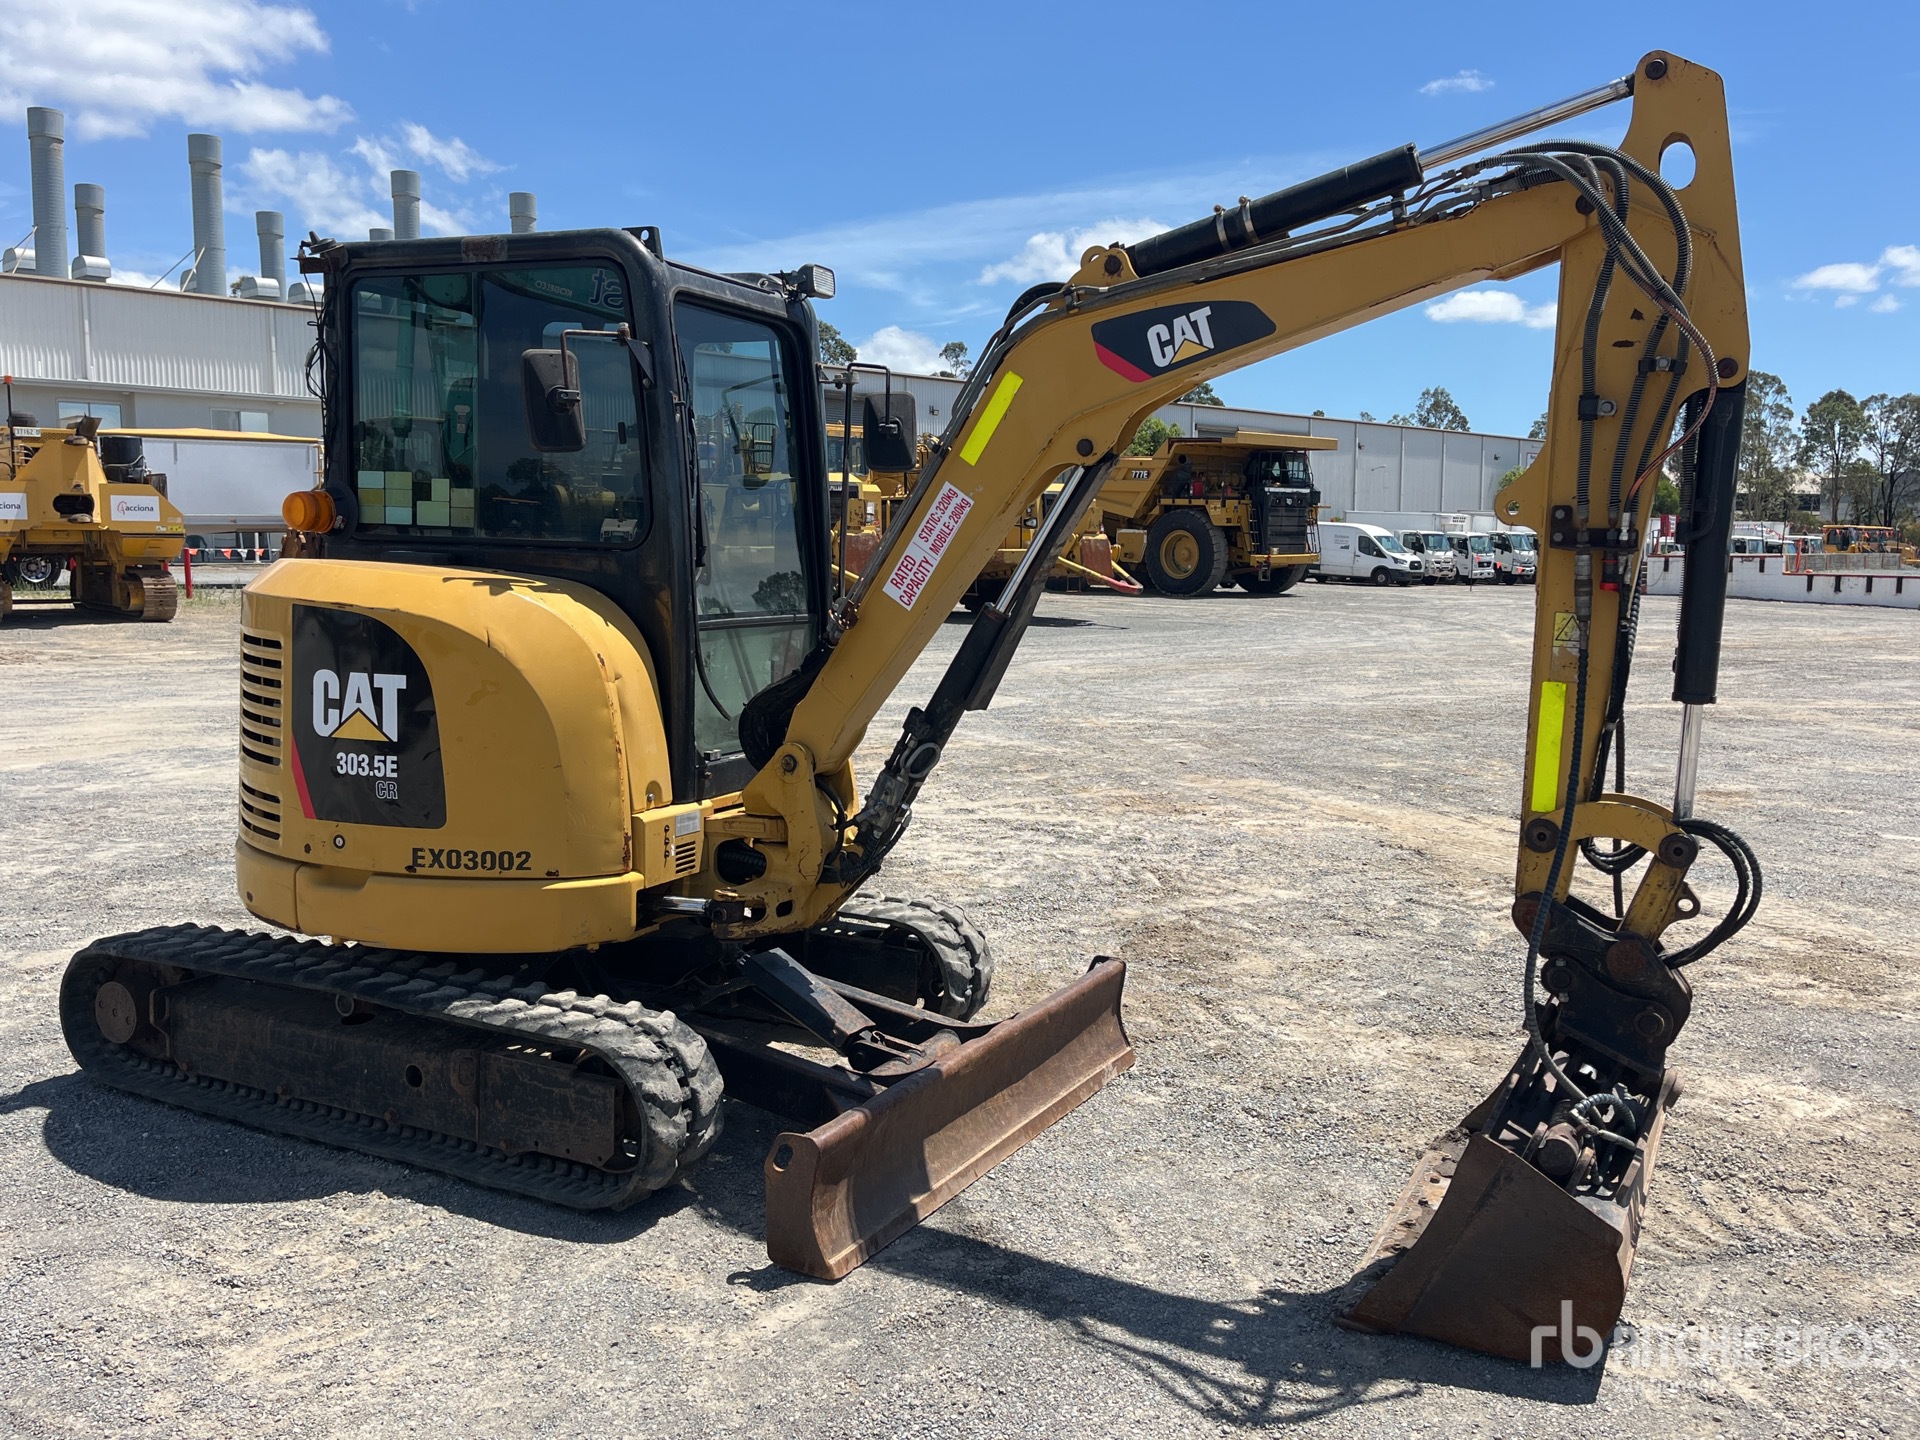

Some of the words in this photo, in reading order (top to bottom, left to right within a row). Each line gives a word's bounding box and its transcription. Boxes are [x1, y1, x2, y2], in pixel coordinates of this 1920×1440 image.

[1146, 305, 1215, 368] CAT
[1131, 470, 1148, 479] 777E
[940, 487, 959, 515] 320kg
[949, 497, 972, 525] 280kg
[890, 554, 917, 590] RATED
[899, 556, 934, 607] CAPACITY
[312, 668, 407, 742] CAT
[336, 752, 398, 778] 303.5E
[375, 780, 398, 800] CR
[411, 847, 532, 871] EX03002
